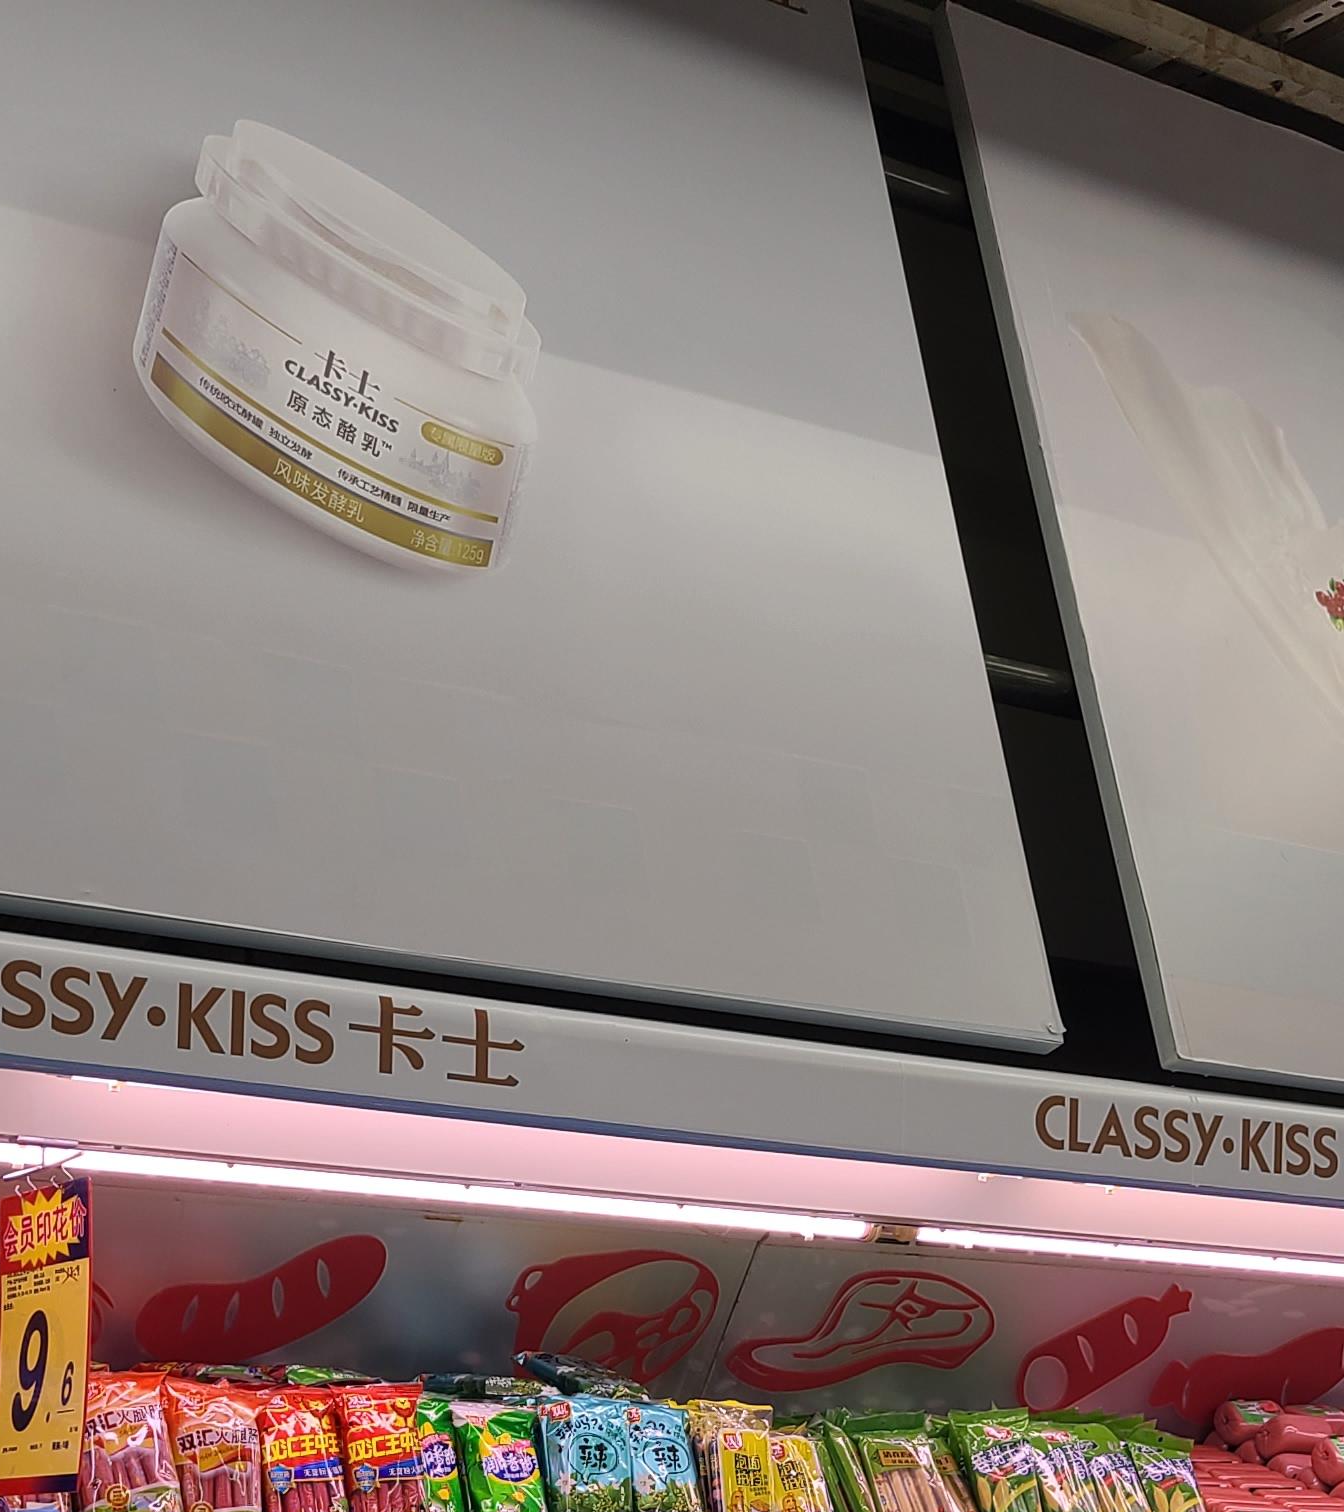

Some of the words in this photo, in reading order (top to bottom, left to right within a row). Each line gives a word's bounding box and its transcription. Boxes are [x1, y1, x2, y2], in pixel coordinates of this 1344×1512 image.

[313, 349, 382, 402] 卡士
[348, 995, 526, 1089] 卡士
[3, 1196, 87, 1261] 会员印花价
